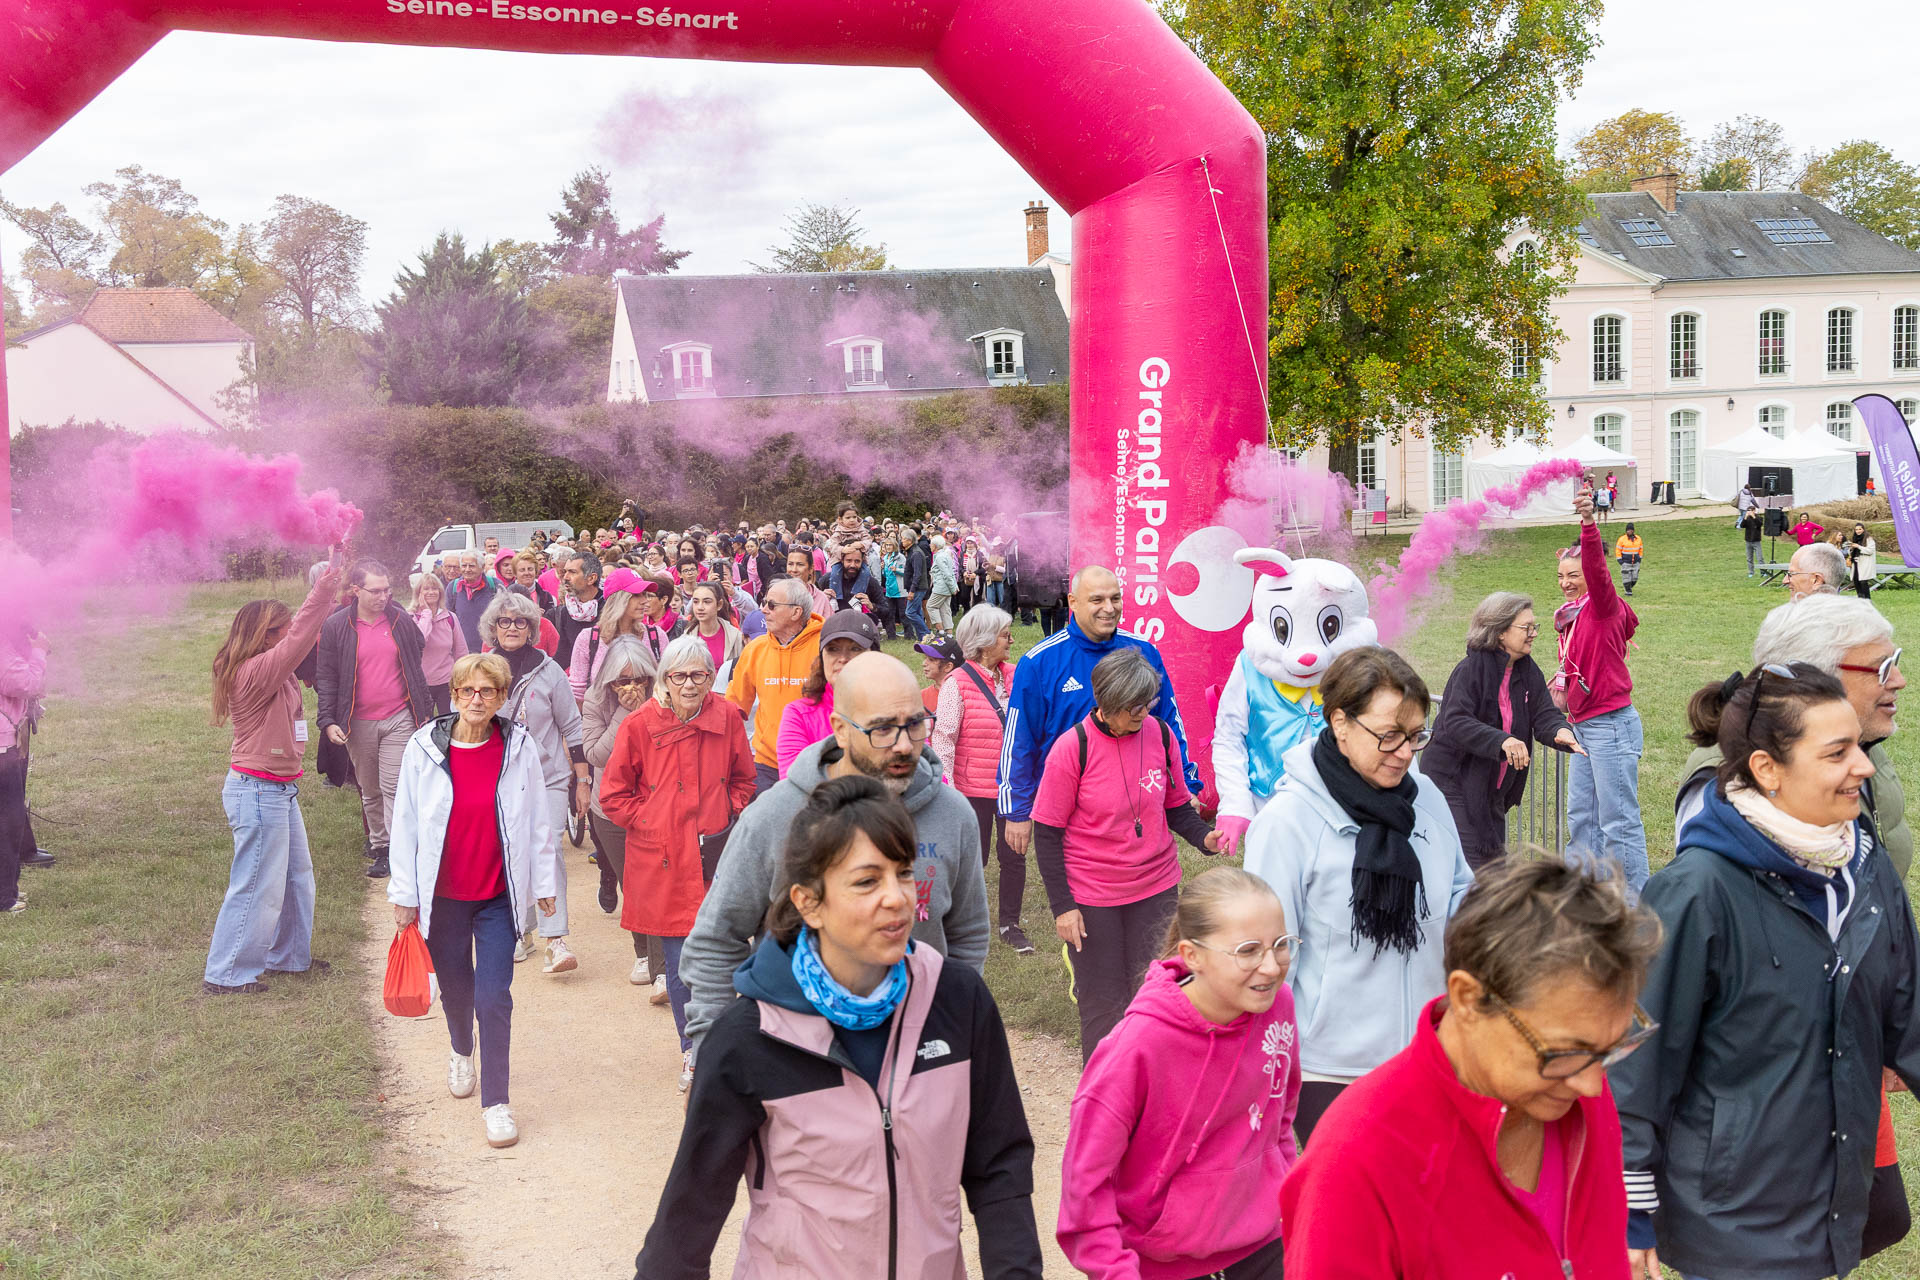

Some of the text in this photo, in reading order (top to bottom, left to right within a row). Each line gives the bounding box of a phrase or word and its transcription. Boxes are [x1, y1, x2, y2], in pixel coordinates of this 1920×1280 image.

[386, 0, 738, 30] Seine-Essonne-Sénart
[1134, 356, 1171, 648] Grand Paris S
